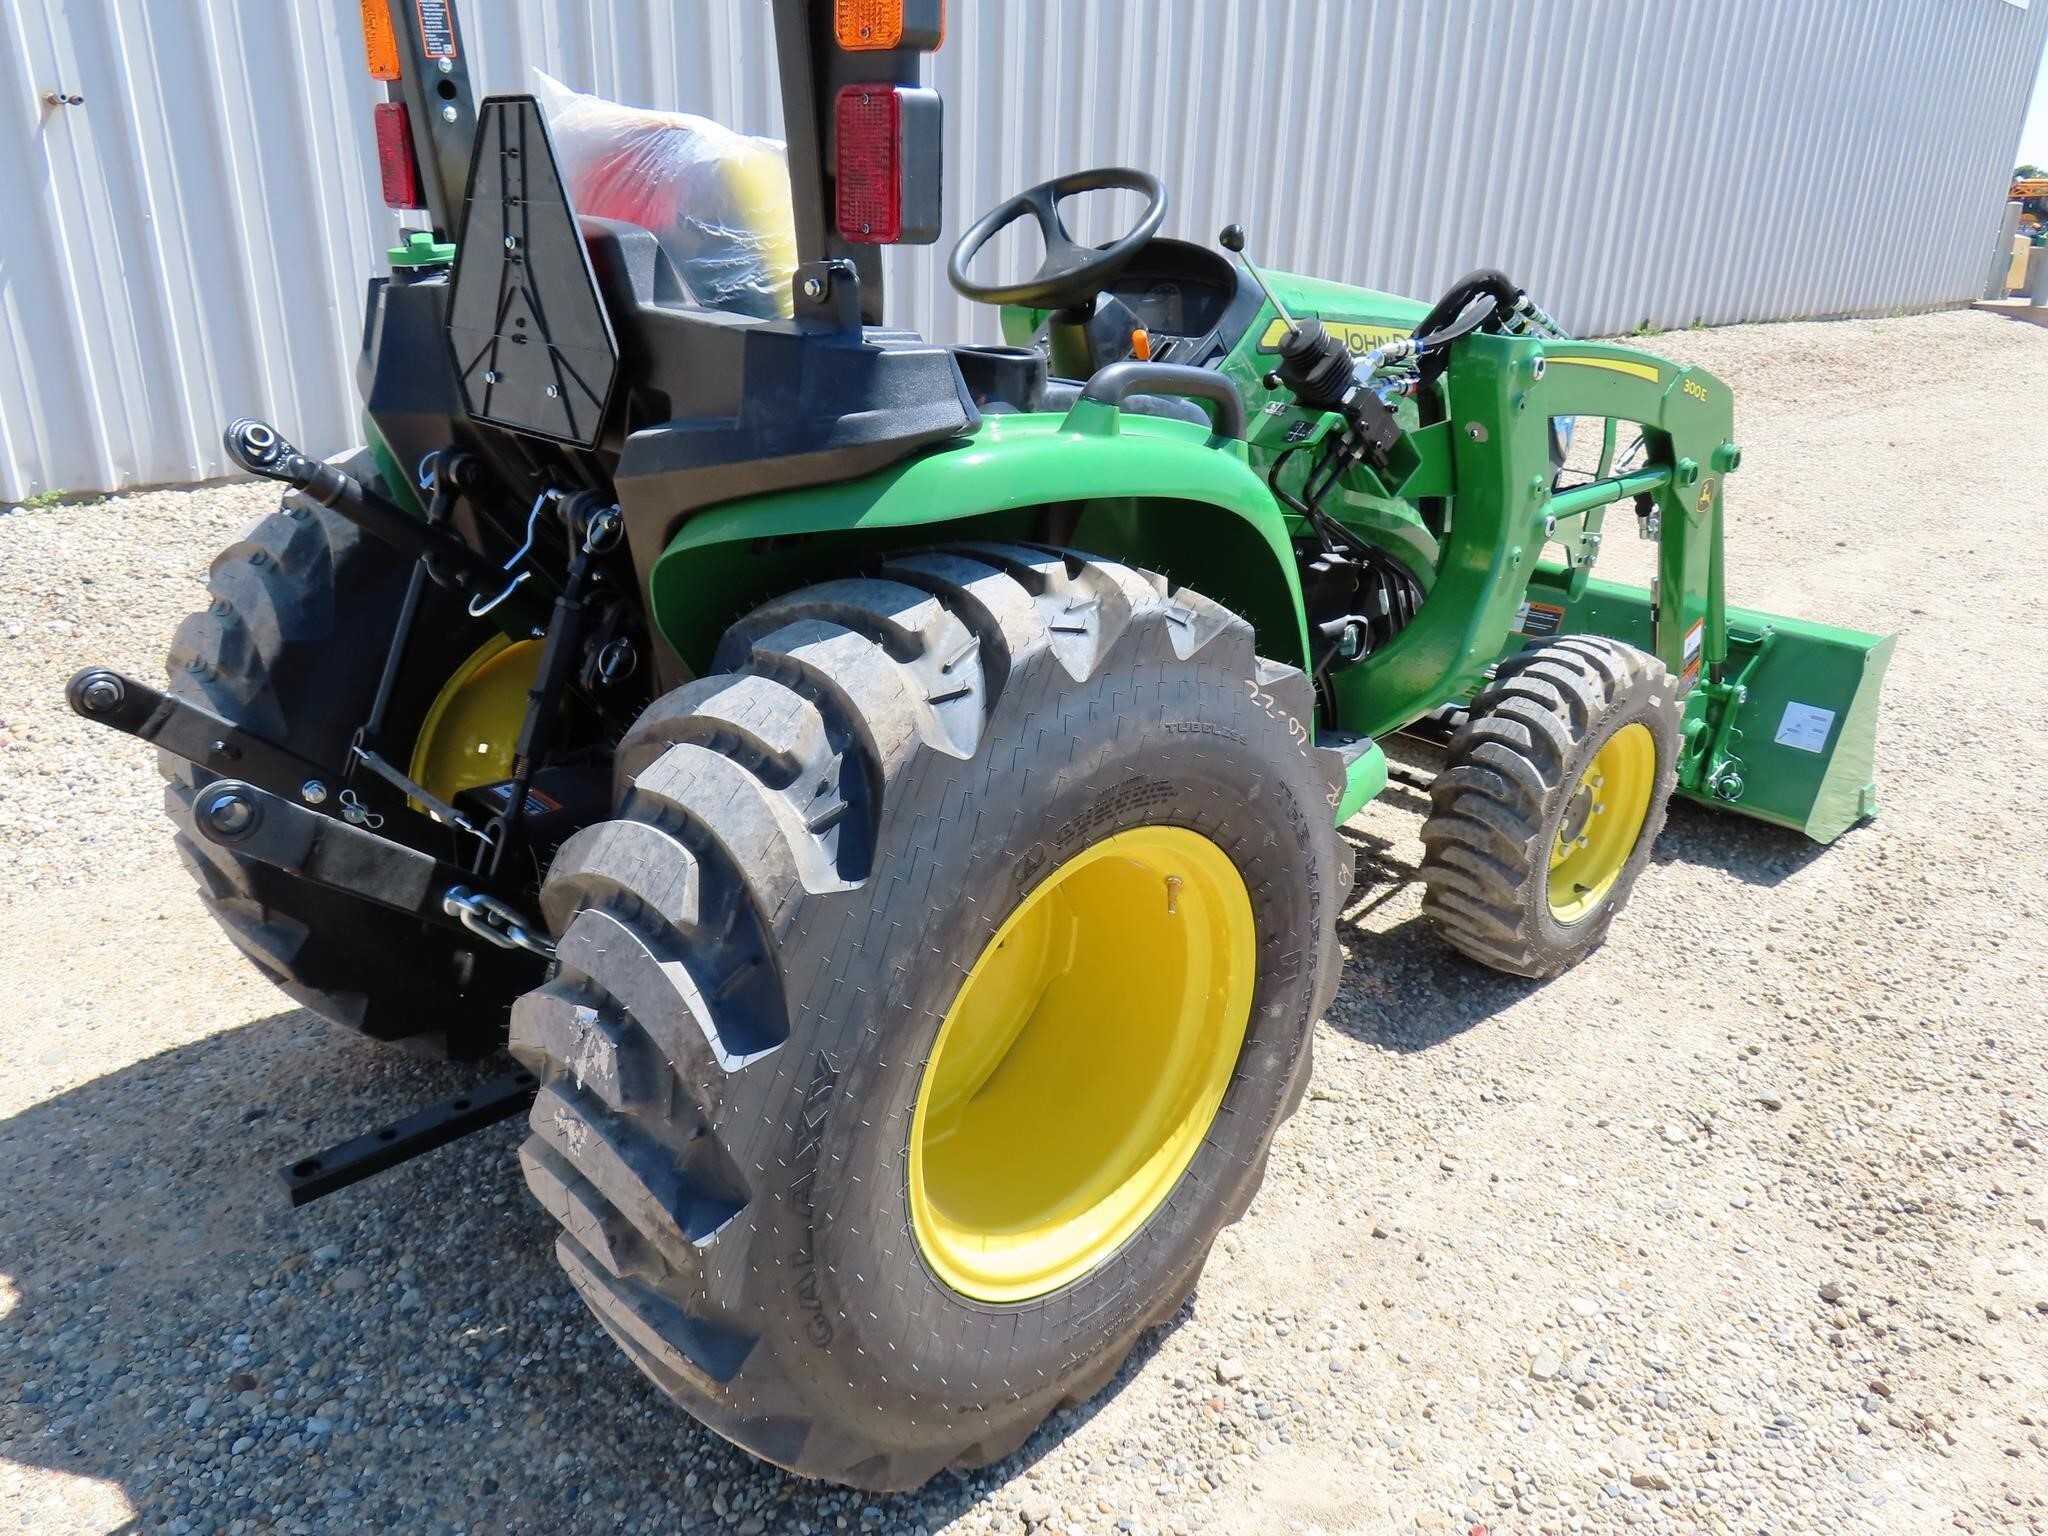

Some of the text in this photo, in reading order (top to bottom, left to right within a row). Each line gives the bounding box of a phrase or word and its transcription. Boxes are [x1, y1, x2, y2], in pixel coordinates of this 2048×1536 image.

[1343, 327, 1389, 354] JOHN
[1682, 378, 1708, 402] 300E
[1164, 721, 1248, 746] TUBELESS
[789, 1048, 840, 1348] GALAXY
